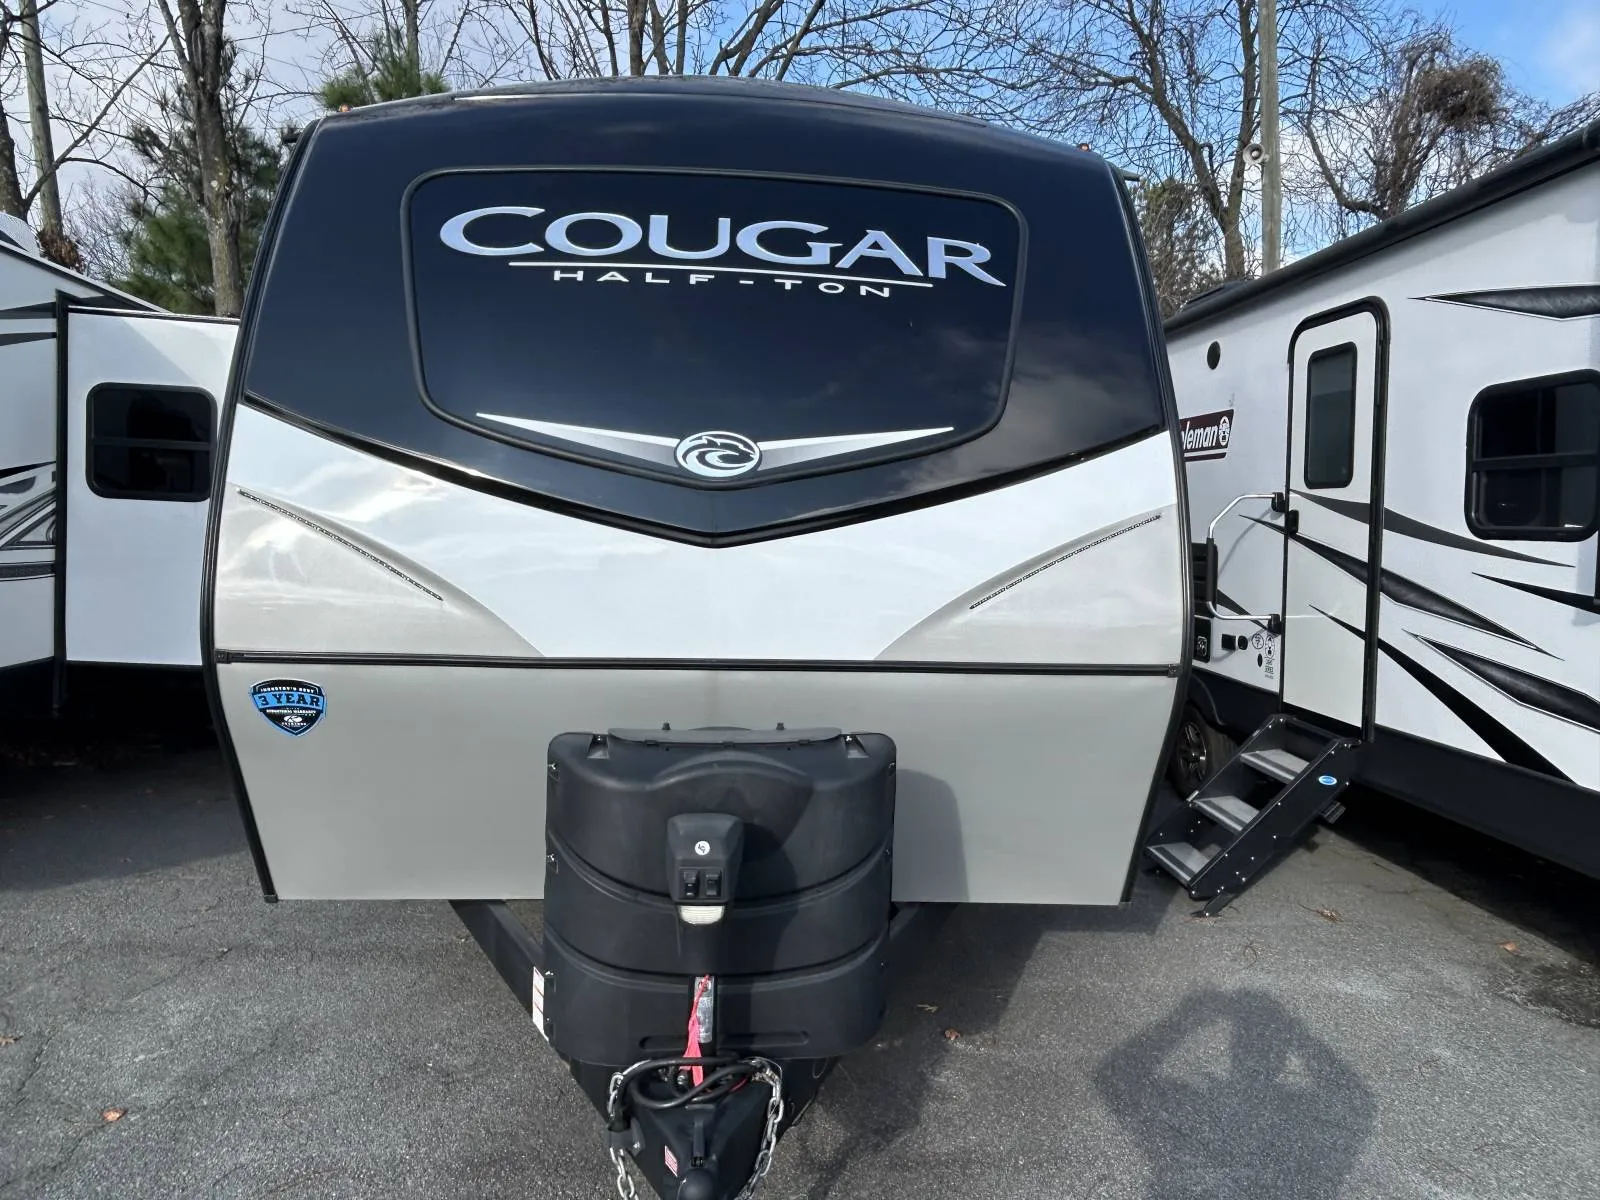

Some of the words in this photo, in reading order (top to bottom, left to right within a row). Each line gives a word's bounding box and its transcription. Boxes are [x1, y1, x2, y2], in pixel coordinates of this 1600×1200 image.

[440, 206, 1007, 287] COUGAR
[258, 695, 269, 706] 3
[272, 693, 320, 706] YEAR
